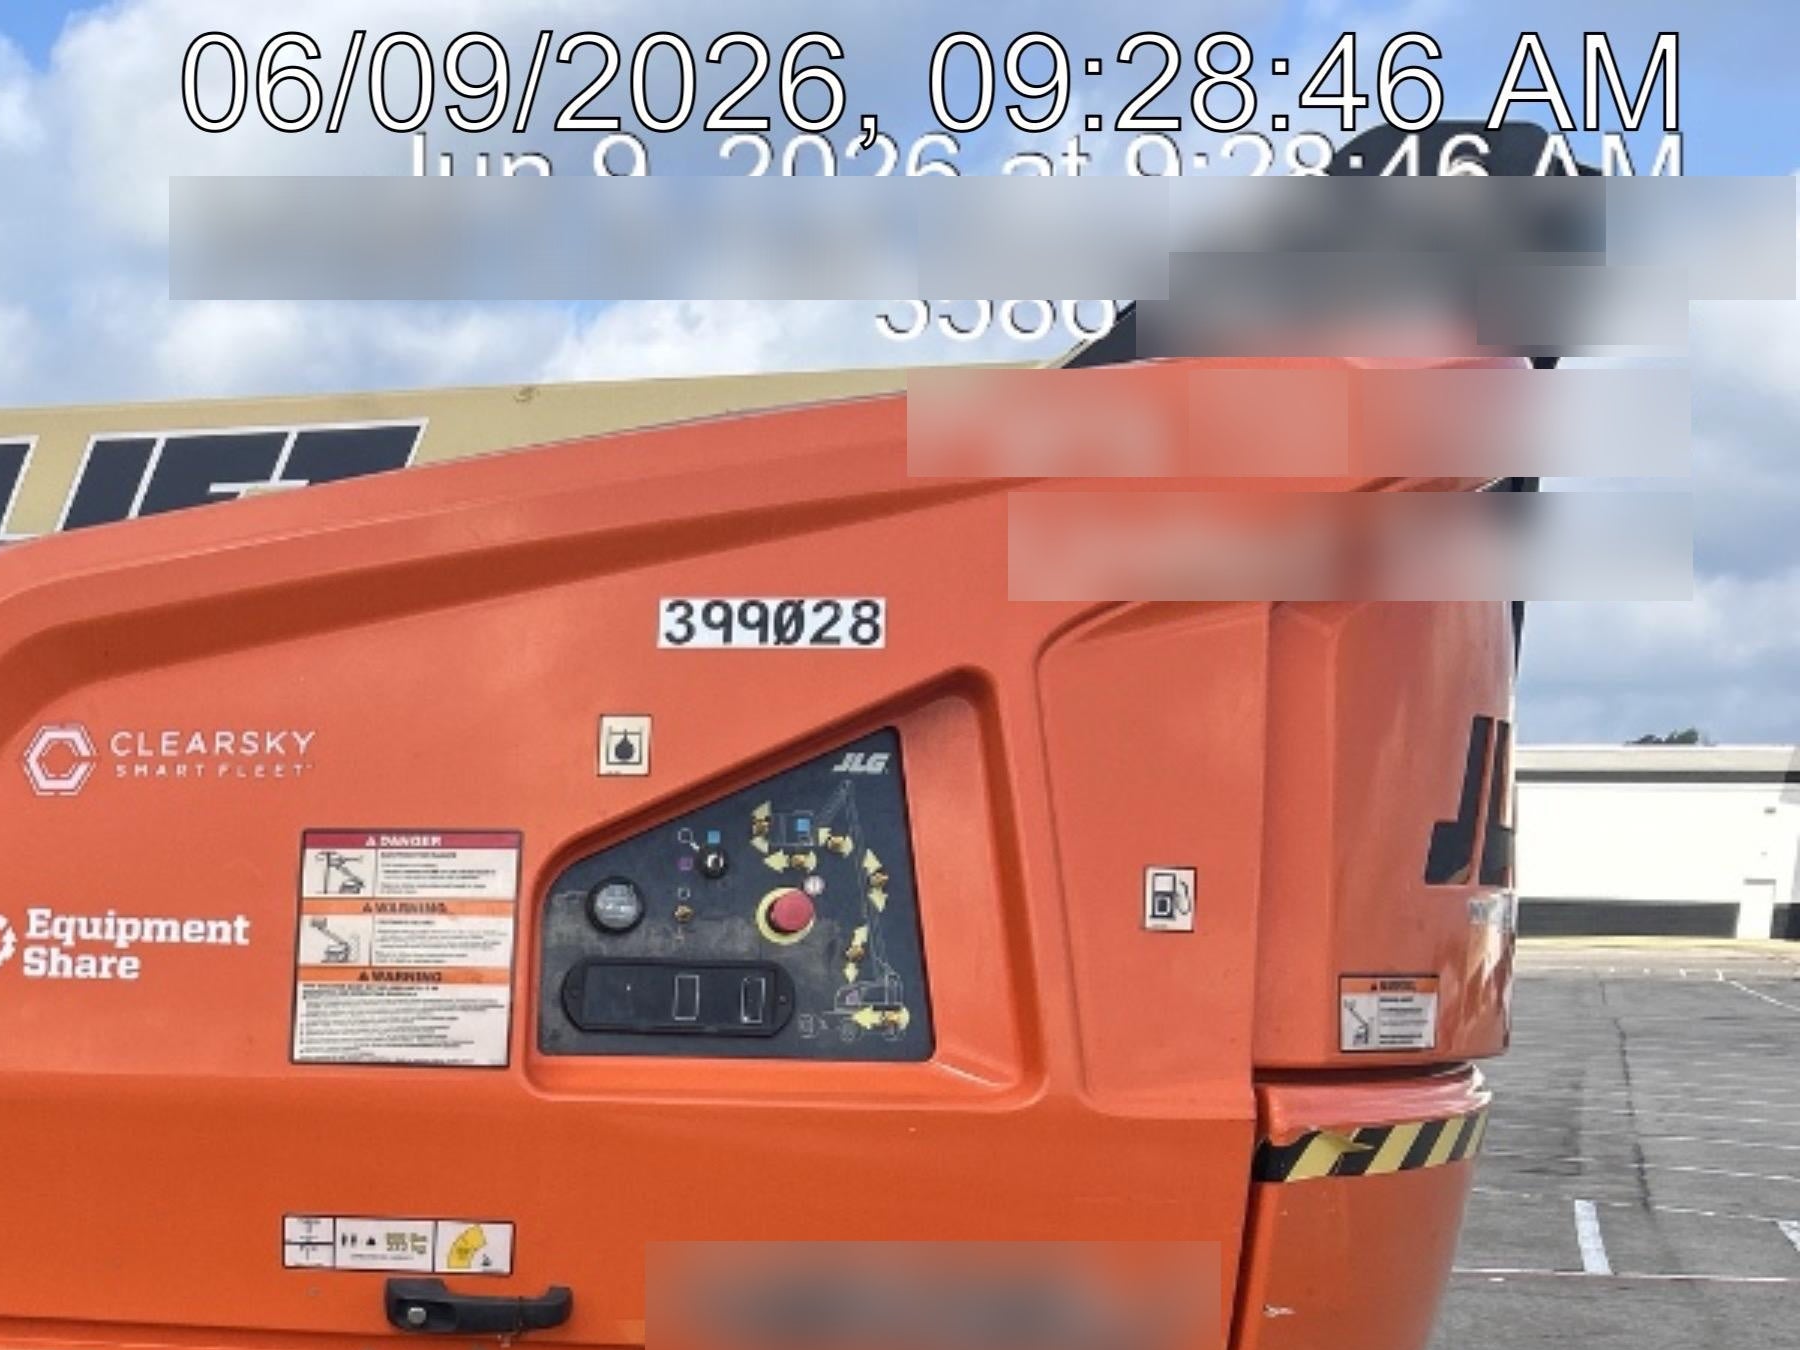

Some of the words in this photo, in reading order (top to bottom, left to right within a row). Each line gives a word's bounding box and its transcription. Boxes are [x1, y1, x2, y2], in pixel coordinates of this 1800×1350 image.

[664, 599, 881, 646] 399028
[110, 730, 316, 757] CLEARSKY
[115, 763, 205, 779] SMART
[832, 752, 891, 775] JLG
[23, 907, 251, 949] Equipment
[22, 946, 142, 979] Share
